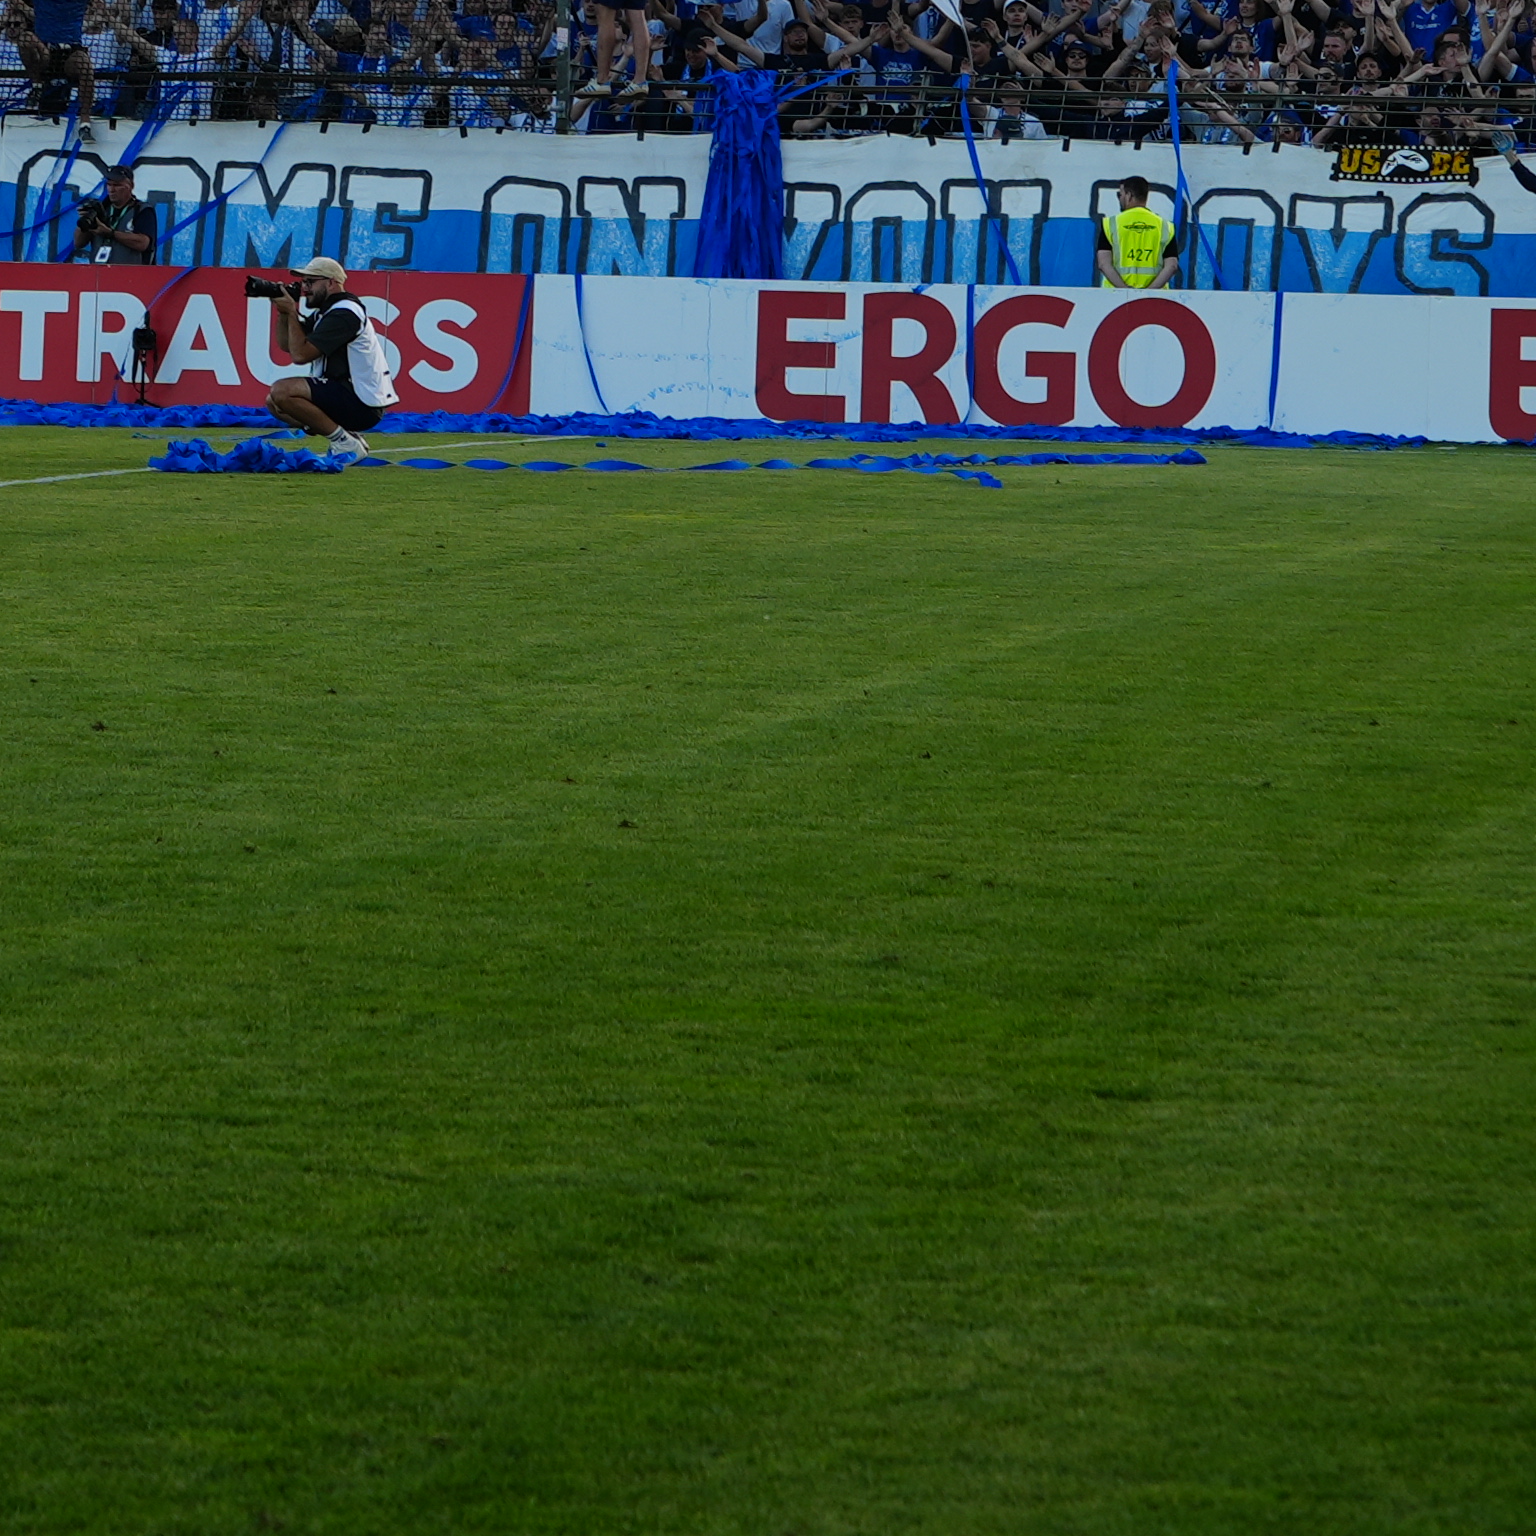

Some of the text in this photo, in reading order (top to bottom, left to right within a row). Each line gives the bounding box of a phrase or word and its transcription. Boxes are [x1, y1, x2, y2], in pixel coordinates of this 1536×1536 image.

[1340, 147, 1381, 175] US
[1127, 249, 1153, 261] 427
[754, 289, 1217, 428] ERGO
